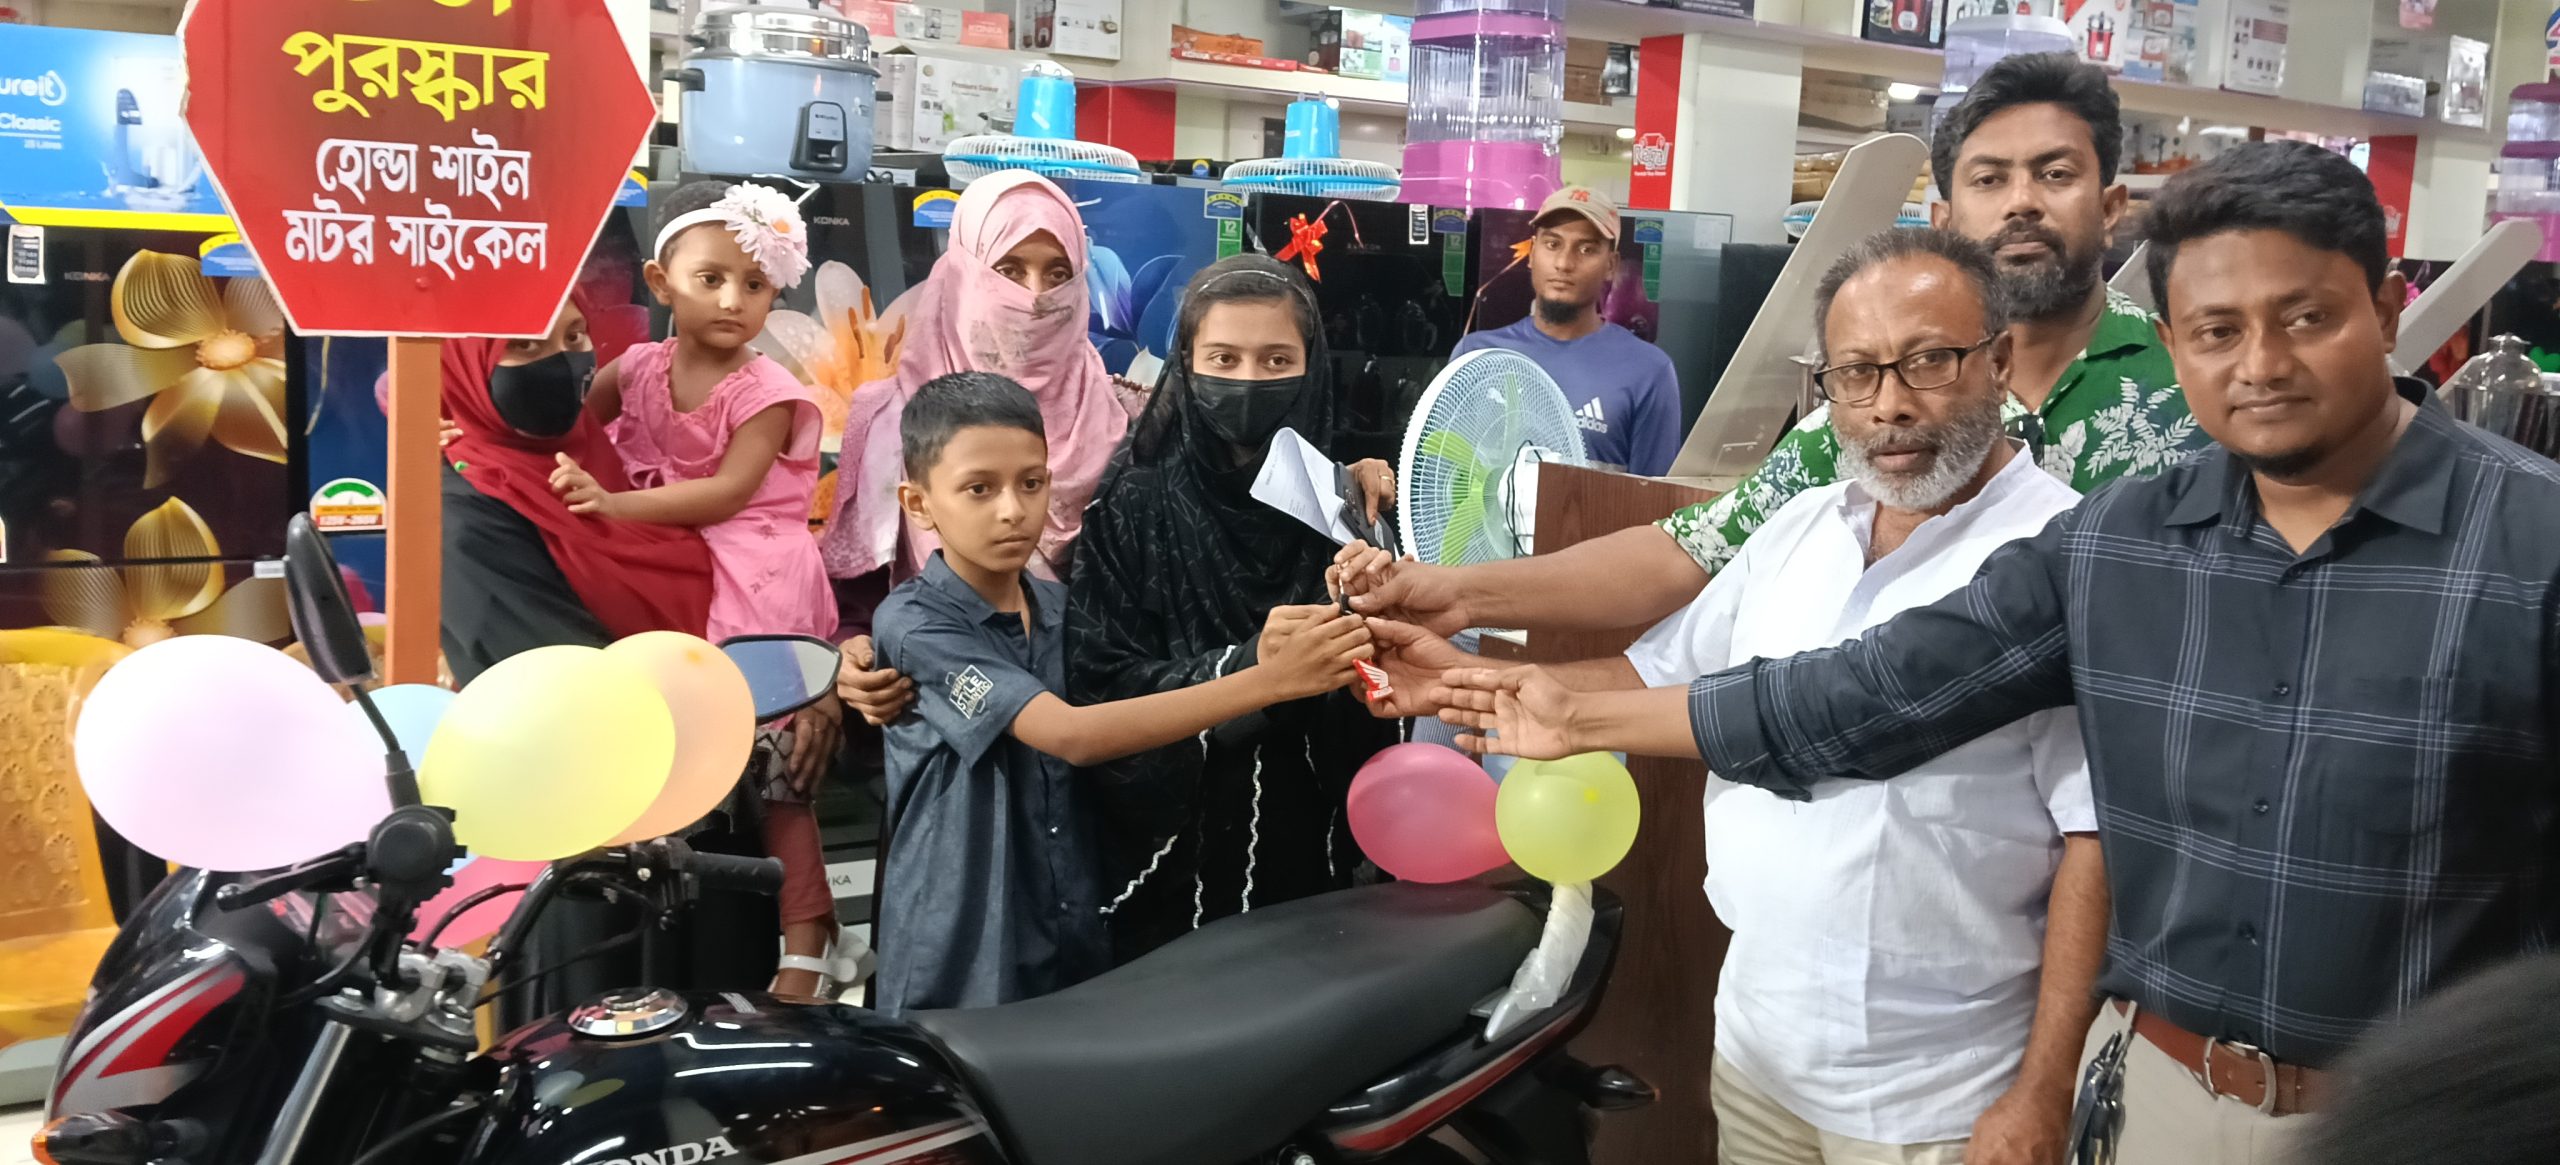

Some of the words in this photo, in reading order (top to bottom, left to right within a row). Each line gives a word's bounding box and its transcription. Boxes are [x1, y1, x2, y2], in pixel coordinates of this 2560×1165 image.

[0, 73, 56, 98] ureit
[281, 31, 550, 122] পুরস্কার
[0, 112, 61, 132] Classic
[316, 138, 418, 204] হোন্ডা
[429, 127, 532, 212] শাইন
[1632, 142, 1671, 171] Regal
[813, 216, 850, 226] KONKA
[1223, 220, 1238, 233] 12
[281, 192, 376, 265] মটর
[386, 197, 548, 280] সাইকেল
[957, 674, 984, 711] STYLE
[584, 1135, 740, 1165] NDA
